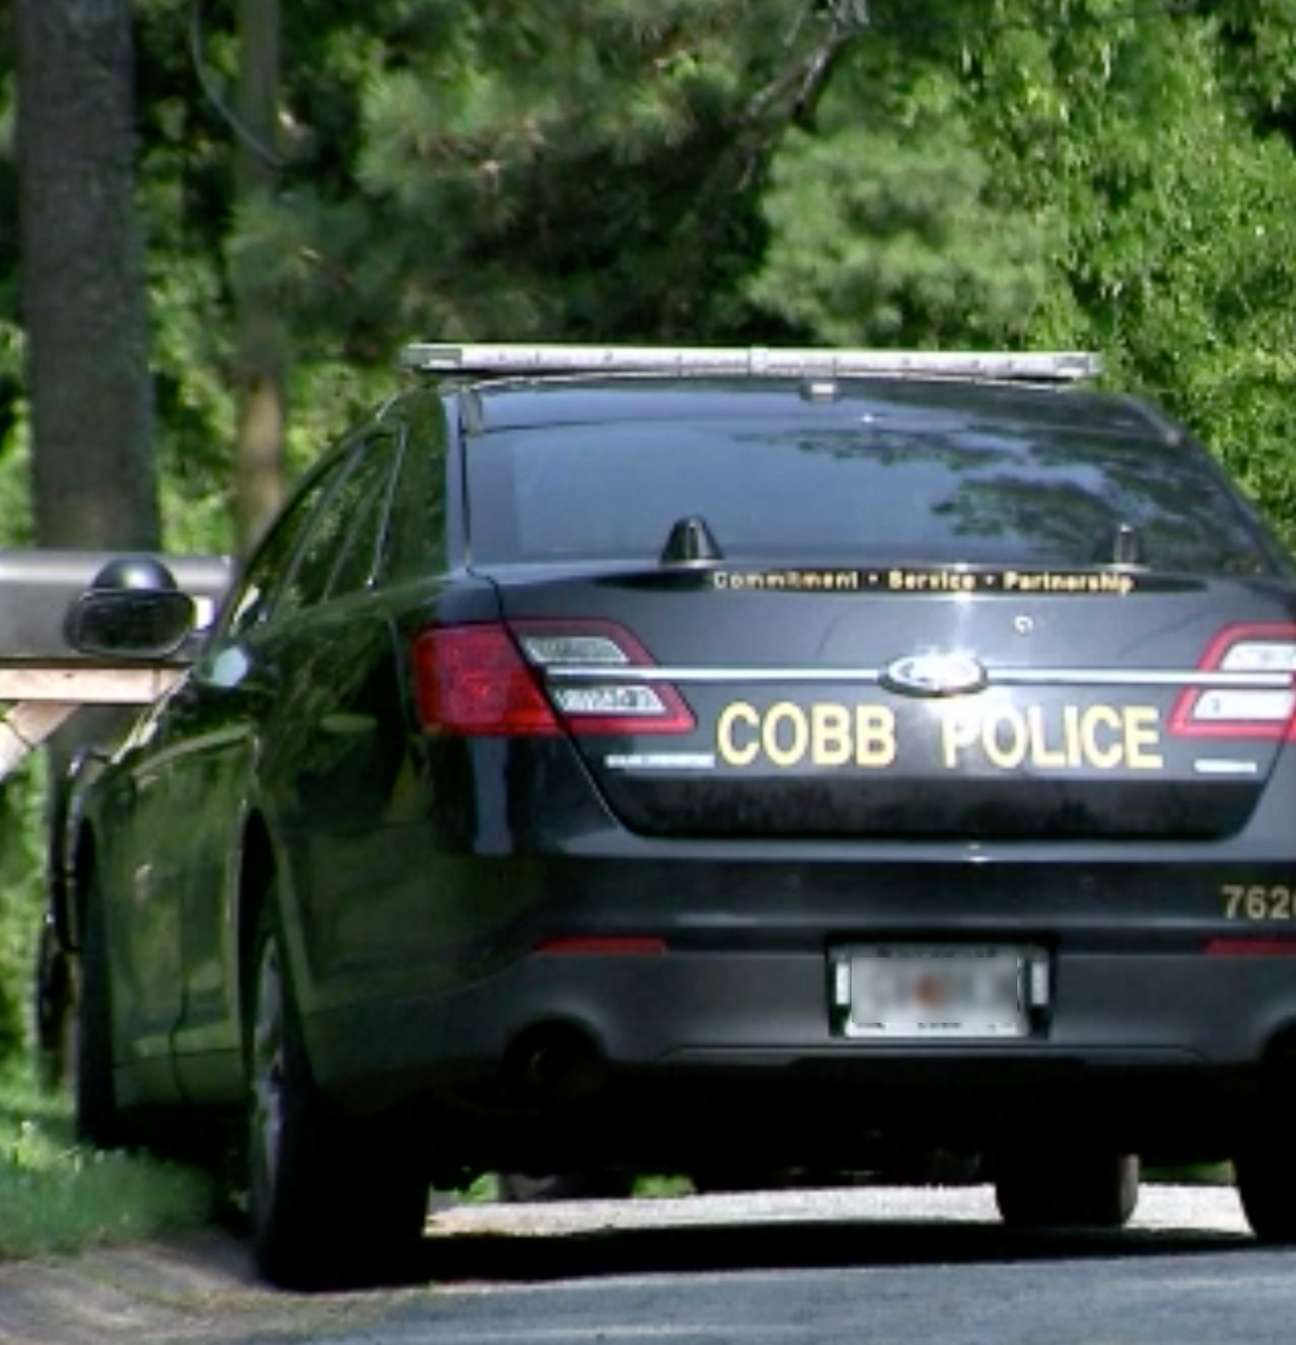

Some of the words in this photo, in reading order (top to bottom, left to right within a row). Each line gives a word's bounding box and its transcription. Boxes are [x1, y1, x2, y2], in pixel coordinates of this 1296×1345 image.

[888, 569, 975, 590] Service
[1003, 571, 1133, 597] Partnership
[717, 702, 897, 768] COBB
[941, 704, 1163, 770] POLICE
